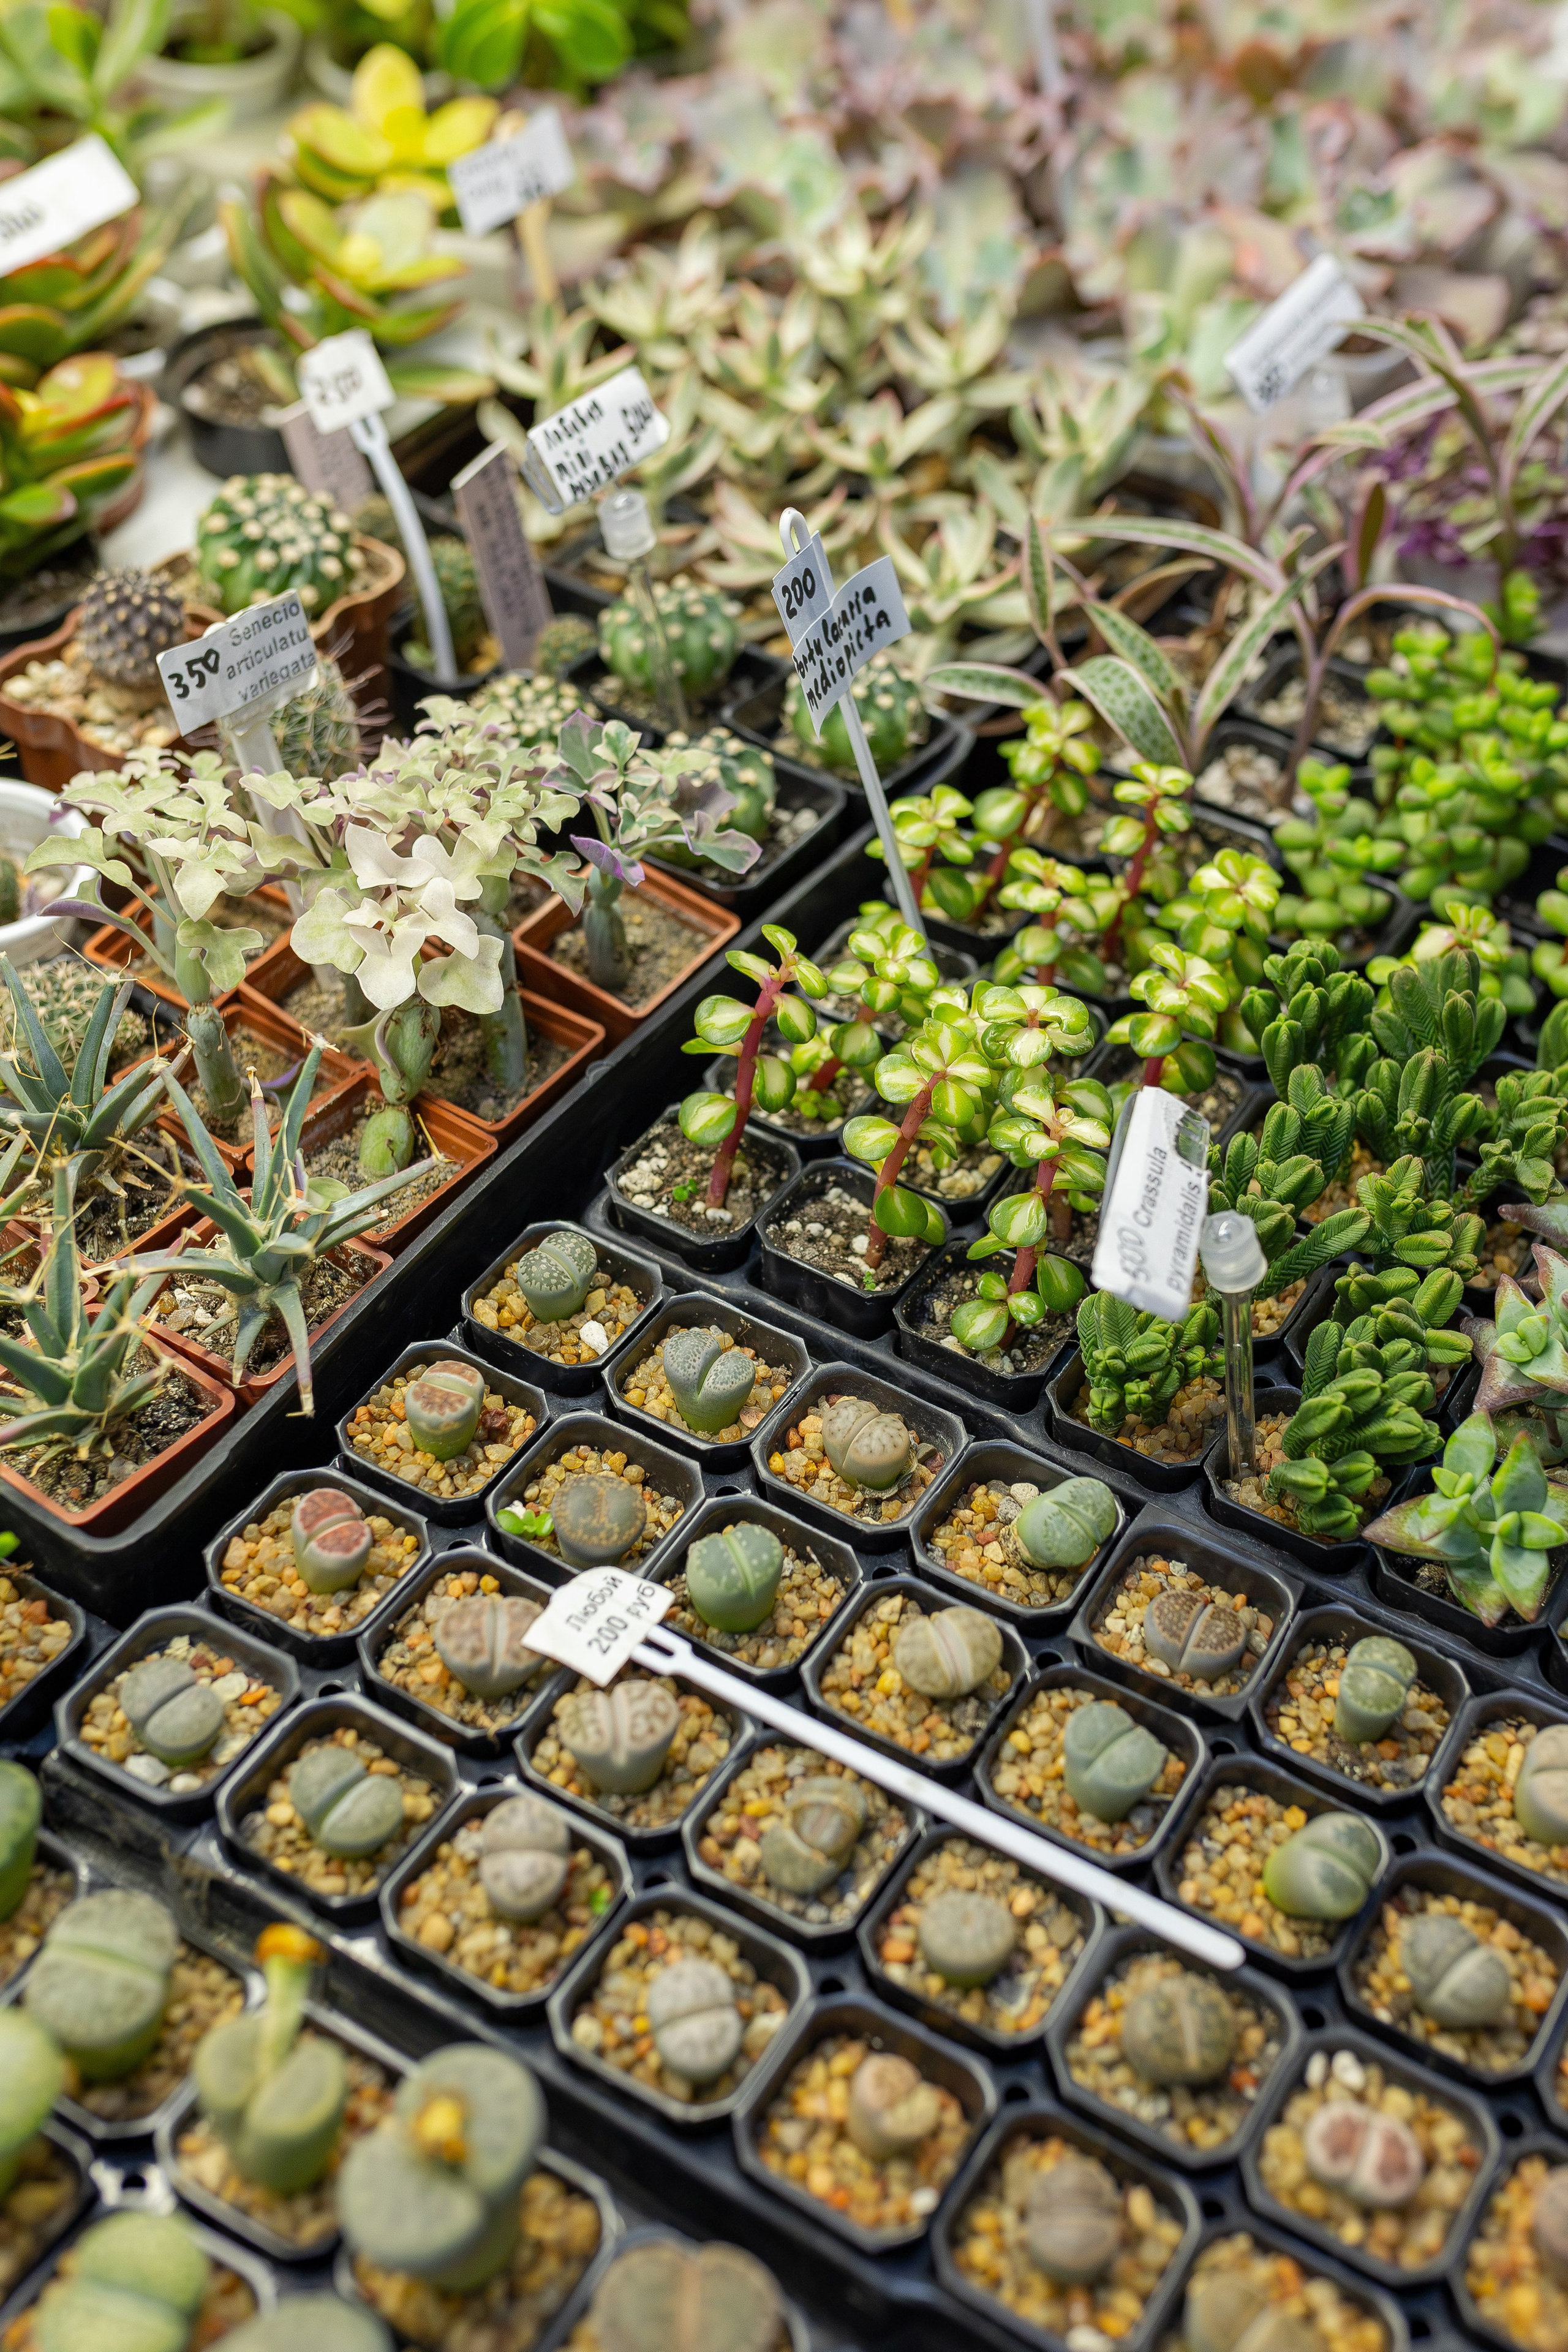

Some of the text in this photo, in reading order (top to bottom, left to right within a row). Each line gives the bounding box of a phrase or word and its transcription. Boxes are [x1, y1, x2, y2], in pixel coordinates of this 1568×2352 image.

[781, 567, 816, 620] 200
[228, 601, 300, 647] Senecio
[167, 647, 221, 699] 350
[238, 652, 316, 703] variegata
[1116, 1146, 1167, 1283] 500 Crassula
[1165, 1181, 1202, 1294] pyramidalis
[565, 1575, 624, 1632] Любой
[587, 1583, 655, 1654] 200 руб
